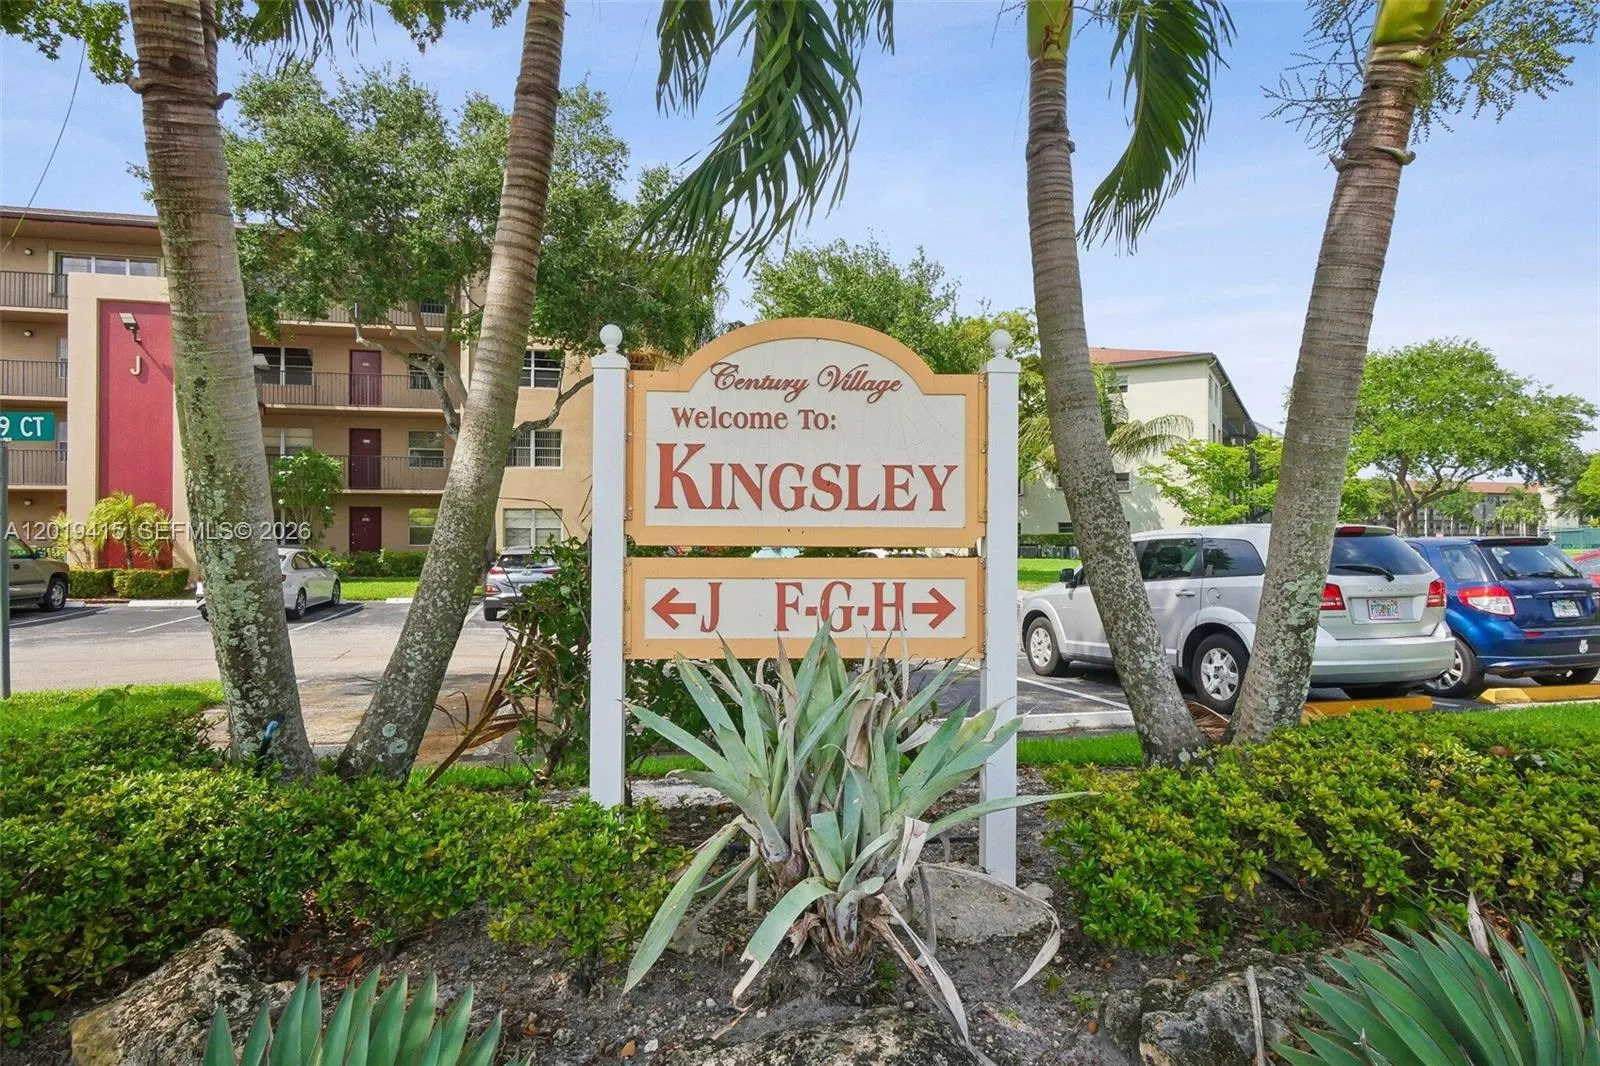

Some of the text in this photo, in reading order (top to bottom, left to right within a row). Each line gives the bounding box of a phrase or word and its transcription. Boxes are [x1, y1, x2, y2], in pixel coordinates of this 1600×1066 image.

[129, 355, 143, 376] J
[711, 362, 903, 404] Century Village
[20, 416, 44, 437] CT
[671, 406, 836, 430] Welcome To:
[654, 442, 958, 512] KINGSLEY
[700, 581, 722, 634] J
